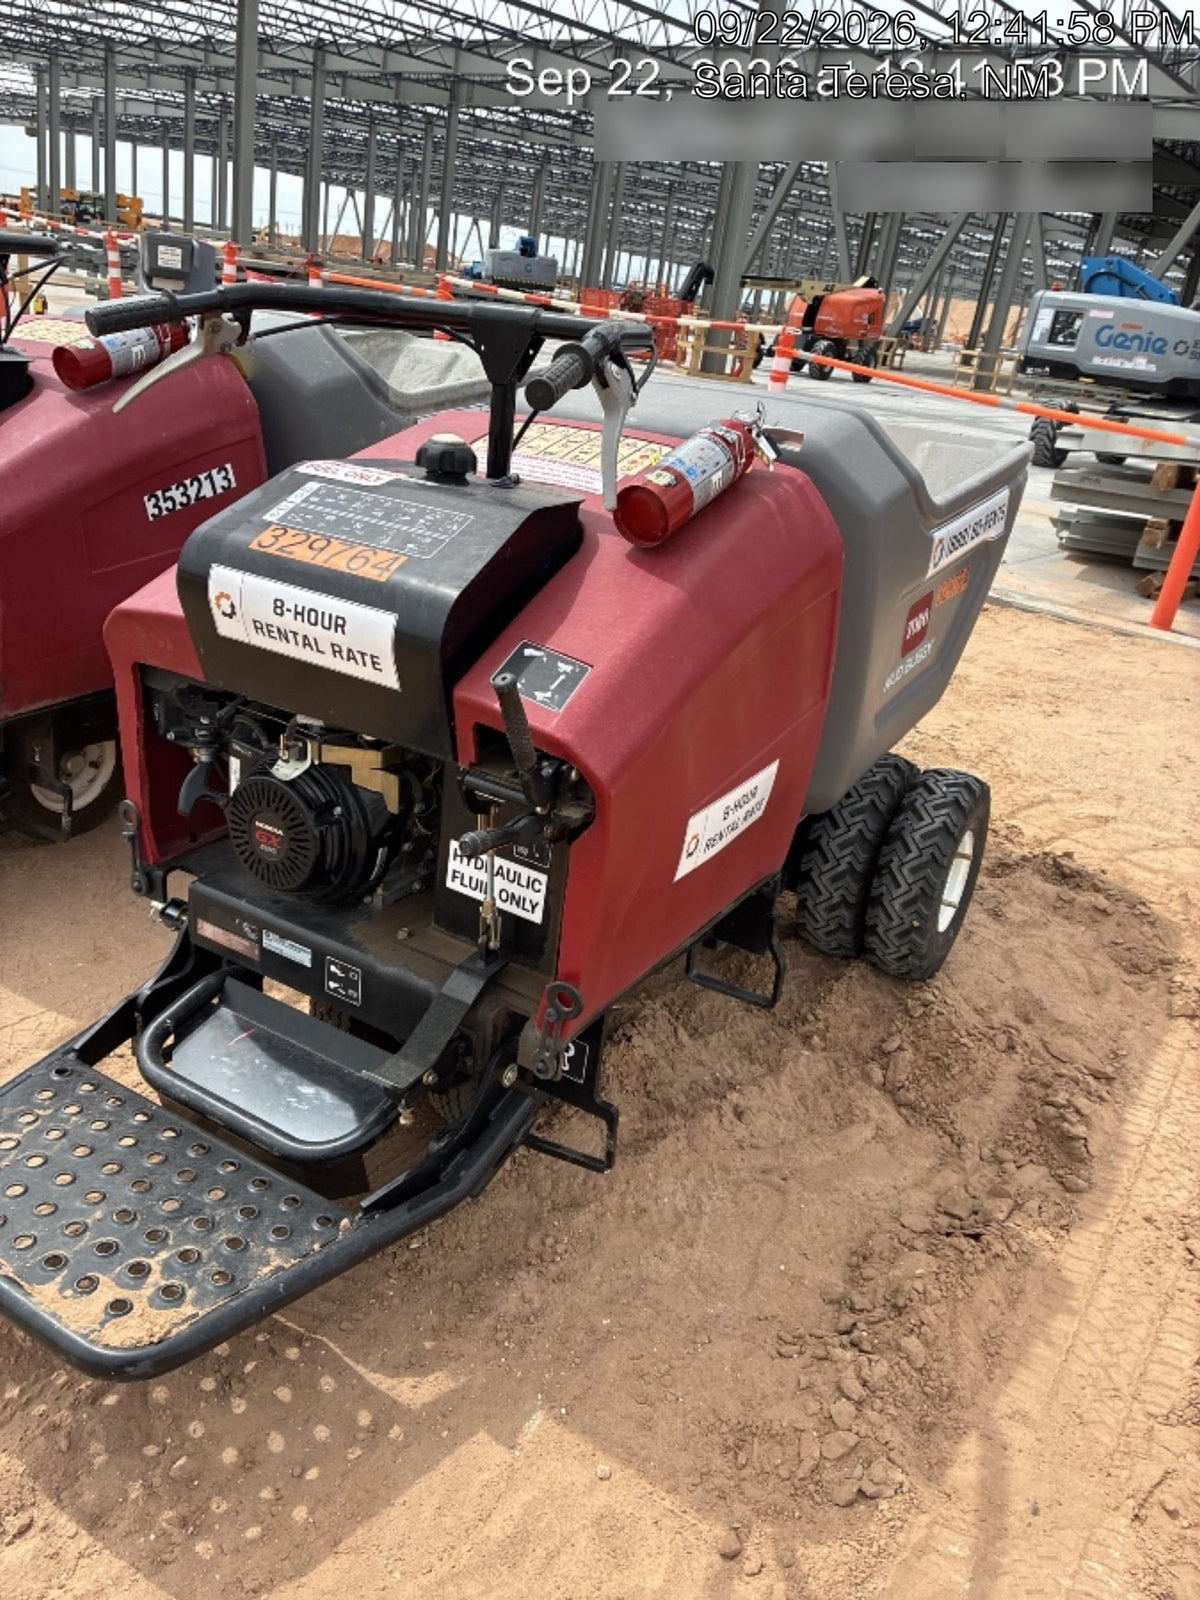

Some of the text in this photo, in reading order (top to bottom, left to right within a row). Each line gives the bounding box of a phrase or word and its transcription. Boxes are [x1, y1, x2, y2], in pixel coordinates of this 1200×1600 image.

[1094, 325, 1168, 354] Genie
[146, 466, 233, 519] 353213
[257, 527, 400, 578] 329764
[273, 598, 348, 636] 8-HOUR
[252, 618, 383, 672] RENTAL RATE
[722, 785, 758, 821] 8-HOUR
[498, 888, 539, 915] ONLY
